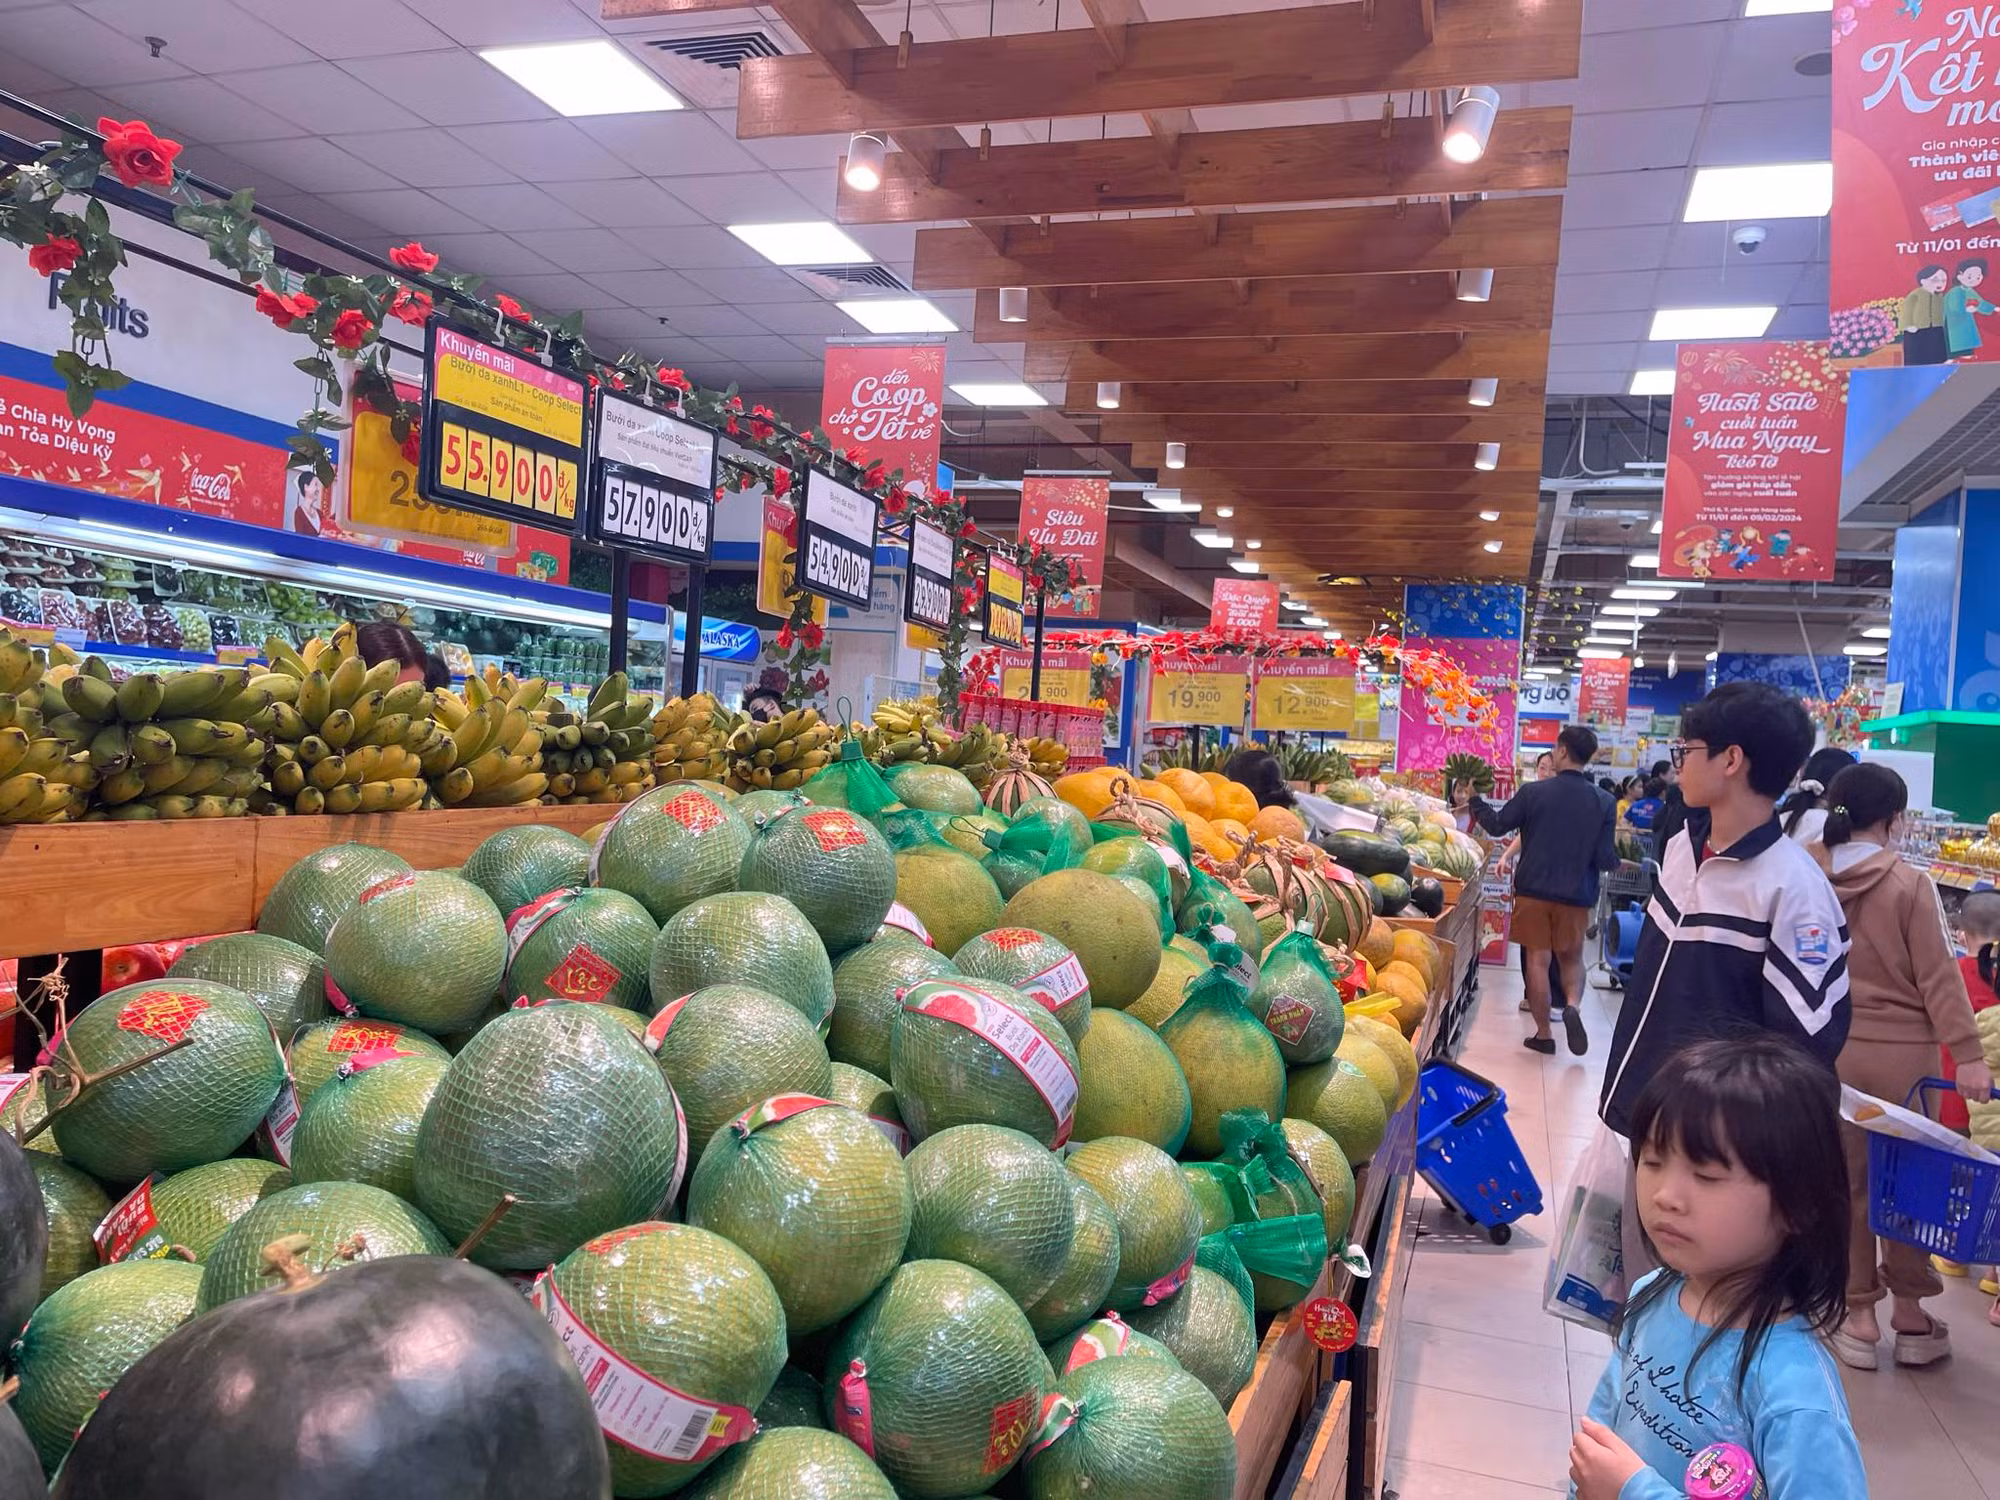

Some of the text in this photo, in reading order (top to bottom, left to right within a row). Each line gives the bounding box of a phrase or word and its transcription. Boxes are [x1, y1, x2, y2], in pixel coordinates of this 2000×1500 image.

[1861, 37, 1985, 113] Kết
[1922, 137, 1988, 151] Gia nhập
[1909, 152, 1967, 168] Thành
[1962, 165, 1992, 179] đãi
[1896, 241, 1920, 254] Từ
[1923, 238, 1961, 253] 11/01
[441, 331, 515, 373] Khuyến mãi
[450, 356, 476, 375] Bưởi
[478, 367, 490, 380] da
[532, 388, 554, 407] Coop
[557, 397, 582, 416] Select
[852, 377, 928, 417] Co.op
[1697, 391, 1819, 414] Flash Sale
[11, 404, 47, 425] Chia
[52, 414, 73, 433] Hy
[77, 419, 116, 444] Vọng
[853, 406, 915, 442] Tết
[911, 423, 936, 440] về
[19, 426, 49, 445] Tỏa
[54, 434, 89, 455] Diệu
[1692, 430, 1831, 454] Mua Ngay
[445, 434, 553, 502] 55.900
[607, 486, 689, 539] 57.900
[1045, 508, 1085, 526] Siêu
[1061, 528, 1098, 546] Đãi
[810, 542, 860, 587] 54.900
[702, 630, 740, 649] ALASKA
[992, 1014, 1014, 1040] Select
[1008, 1026, 1031, 1053] Da Xanh
